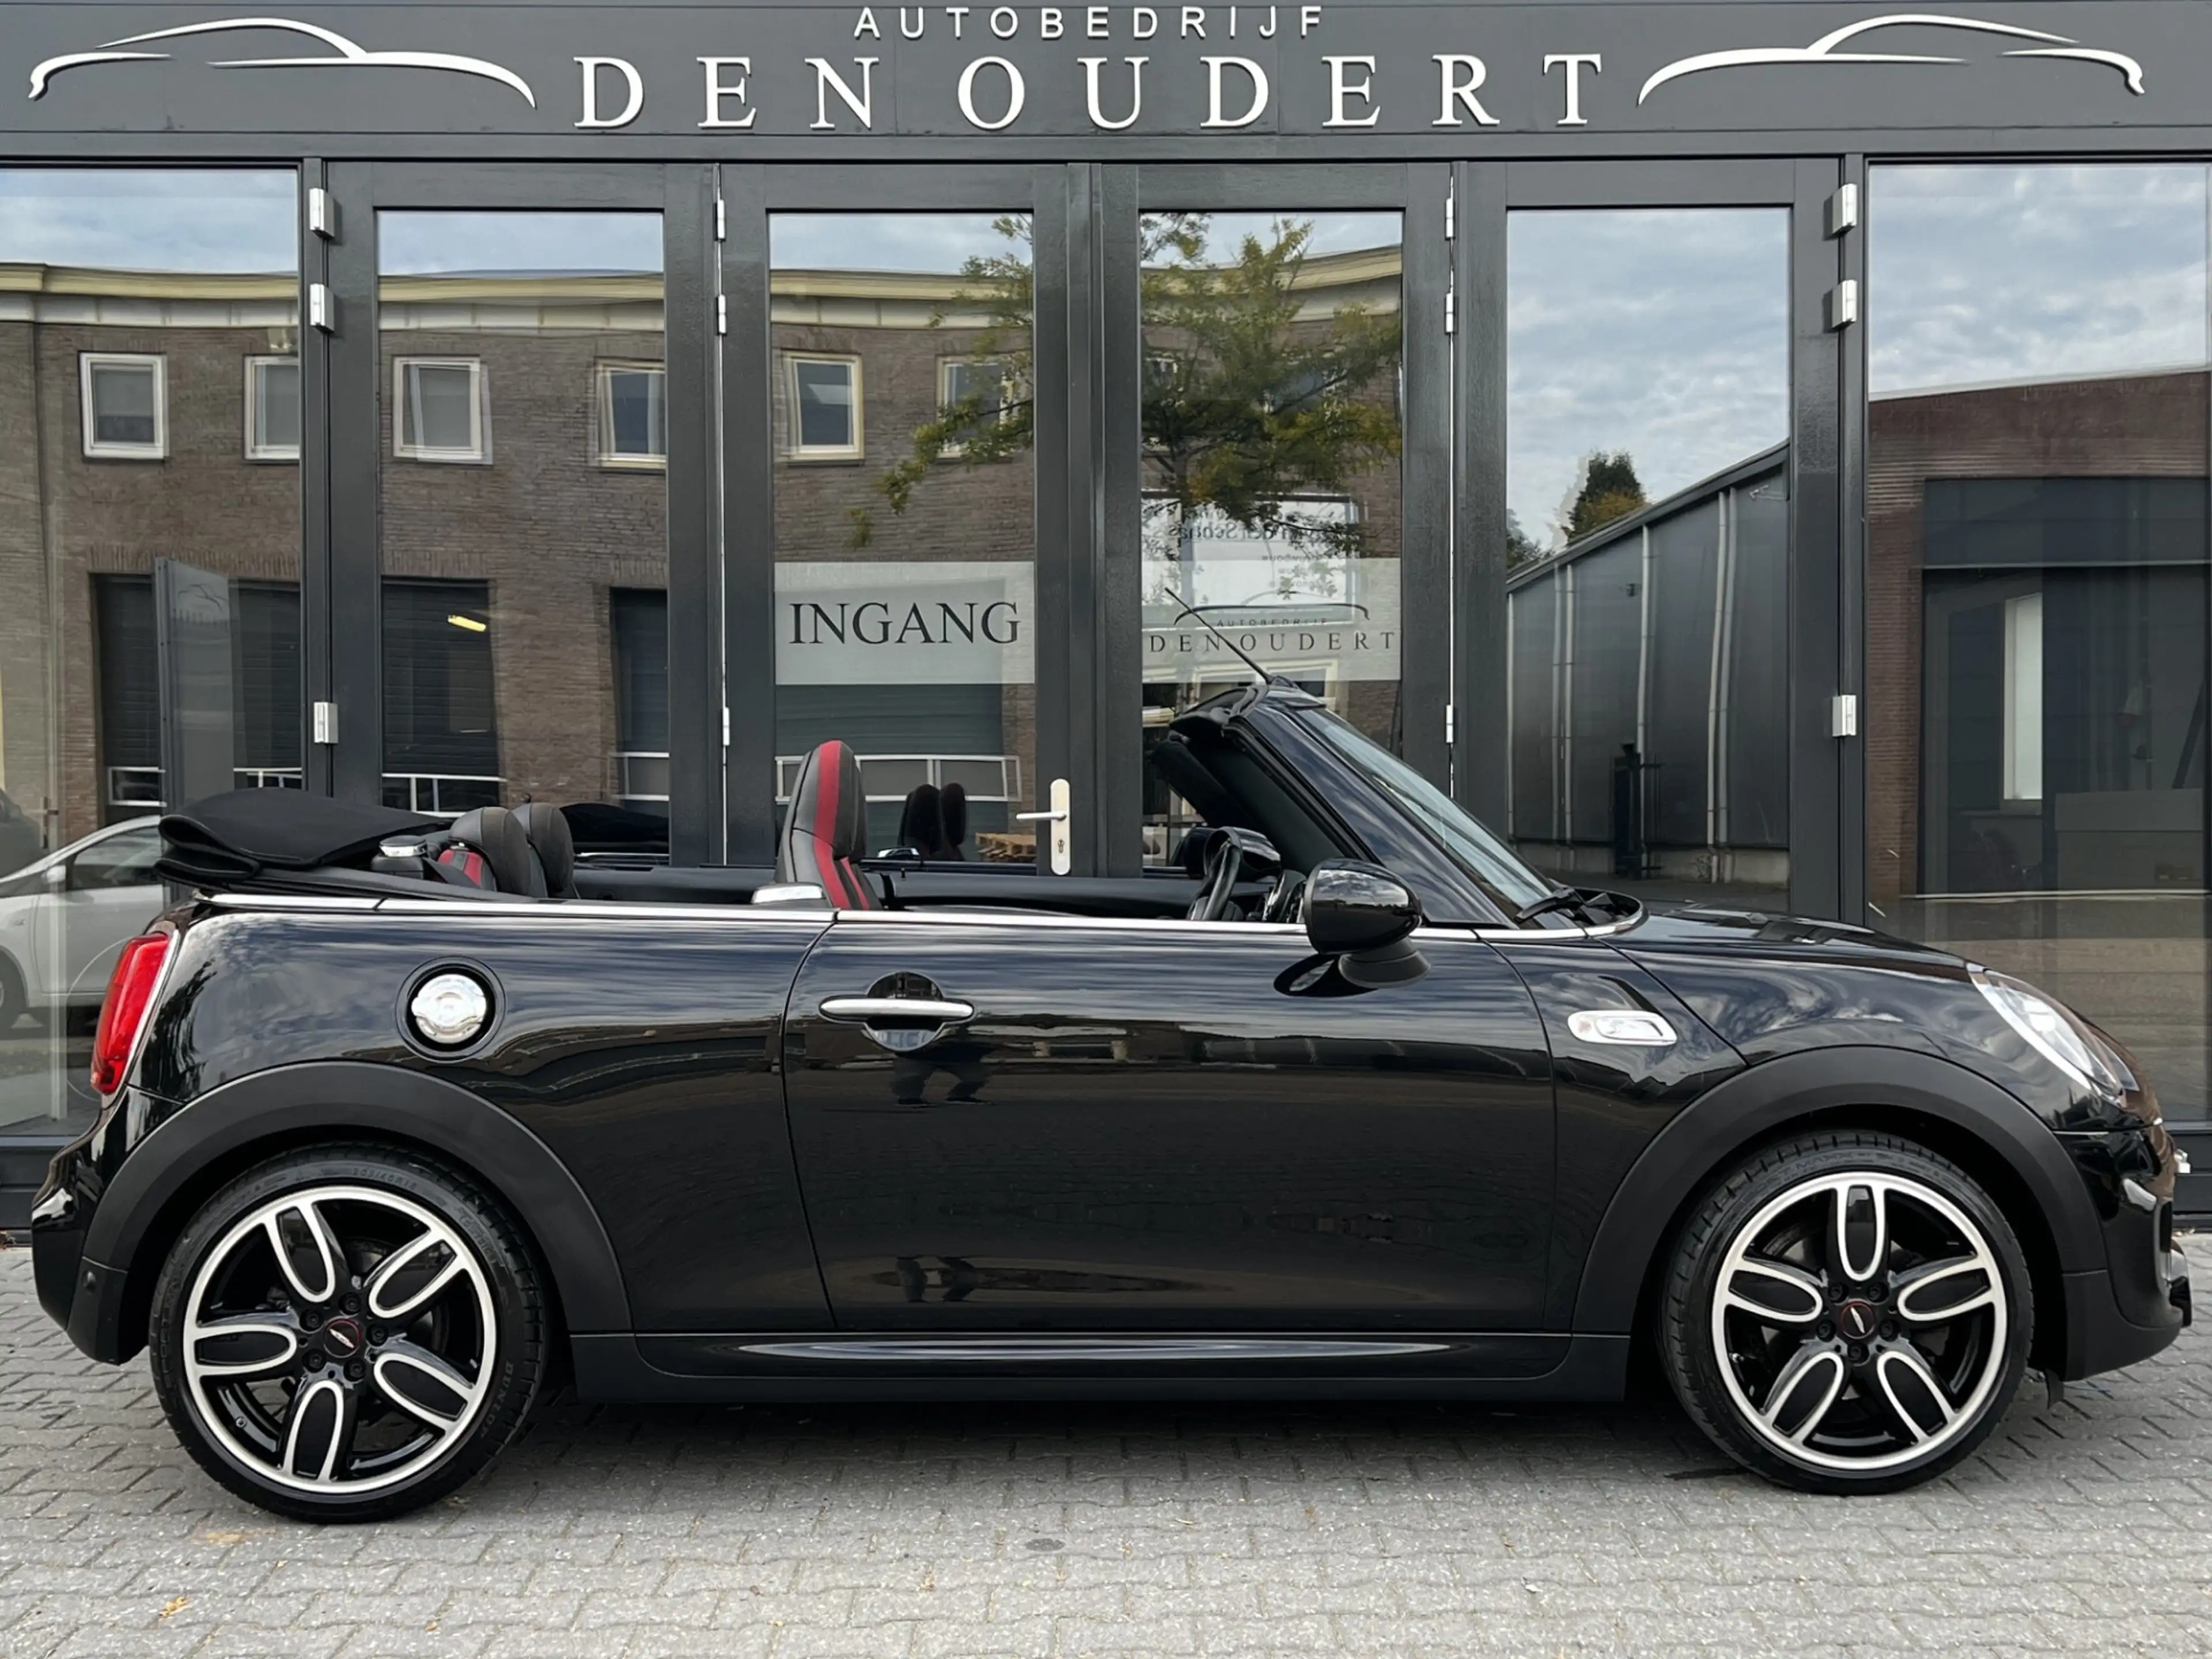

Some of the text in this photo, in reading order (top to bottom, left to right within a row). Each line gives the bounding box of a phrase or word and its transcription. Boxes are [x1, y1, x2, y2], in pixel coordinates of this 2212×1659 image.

[853, 5, 1321, 39] AUTOBEDRIJF
[573, 54, 1603, 131] DEN OUDERT
[788, 601, 1022, 645] INGANG
[1149, 631, 1396, 653] DEN OUDERT
